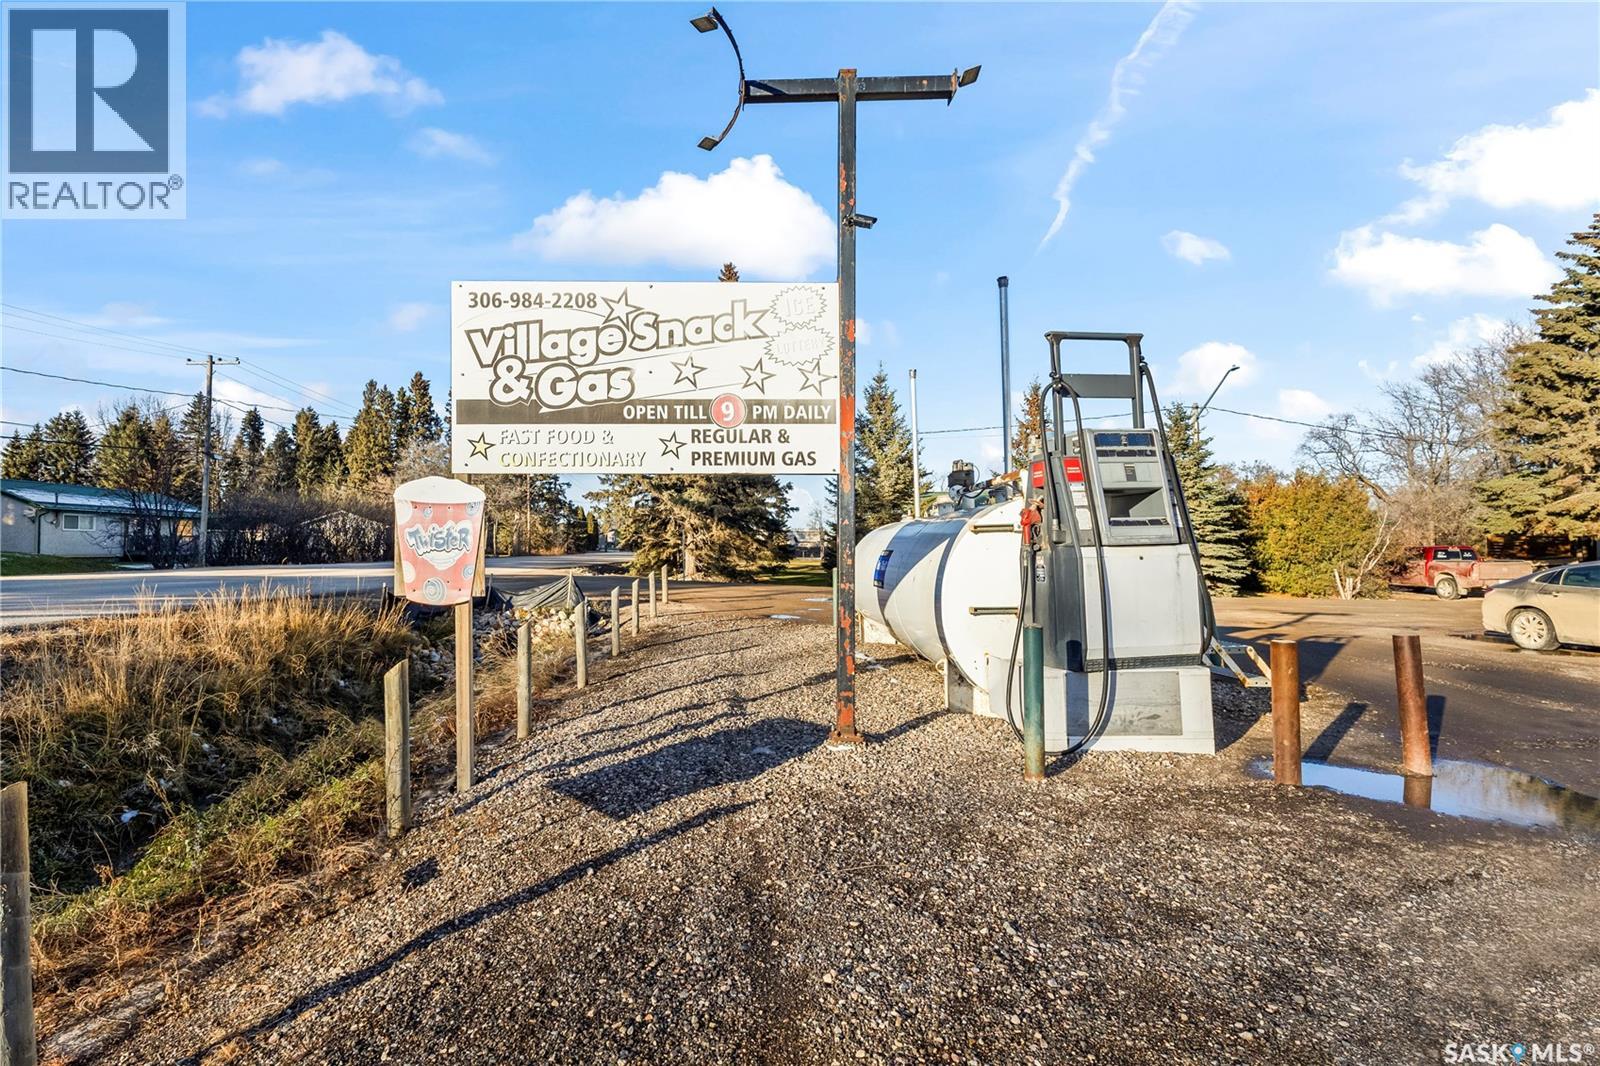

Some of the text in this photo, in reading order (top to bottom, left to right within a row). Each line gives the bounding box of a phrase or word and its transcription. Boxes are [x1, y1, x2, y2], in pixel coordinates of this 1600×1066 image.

[468, 292, 598, 309] 306-984-2208
[464, 299, 770, 369] Village Snack
[489, 354, 635, 409] & Gas
[623, 400, 831, 422] OPEN TILL 9 PM DAILY
[500, 429, 614, 445] FAST FOOD &
[691, 428, 790, 444] REGULAR &
[500, 451, 647, 467] CONFECTIONARY
[691, 451, 817, 466] PREMIUM GAS
